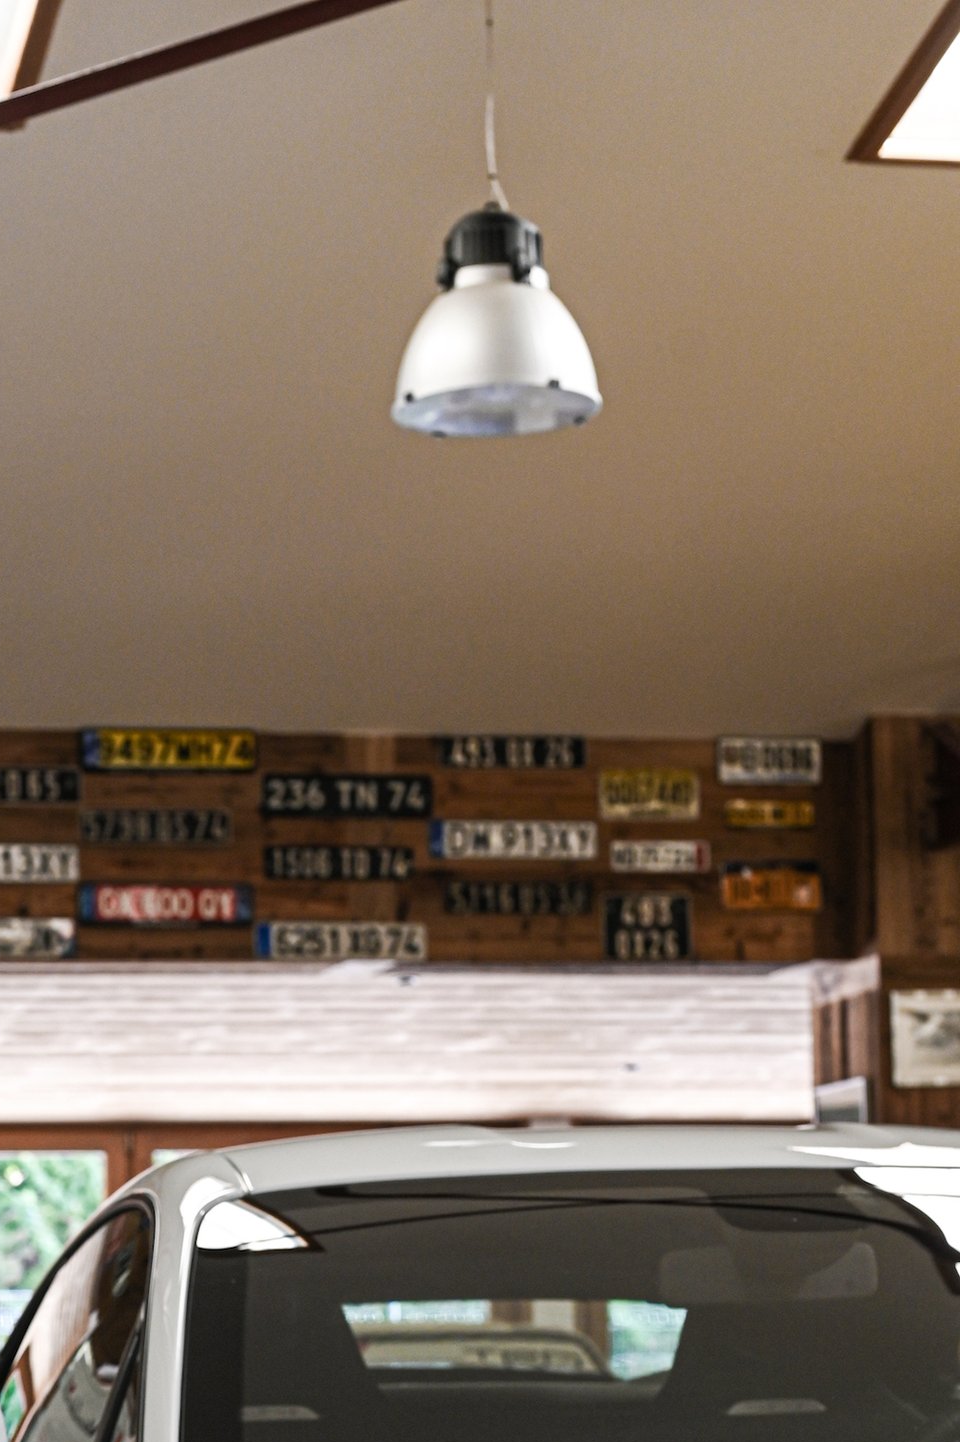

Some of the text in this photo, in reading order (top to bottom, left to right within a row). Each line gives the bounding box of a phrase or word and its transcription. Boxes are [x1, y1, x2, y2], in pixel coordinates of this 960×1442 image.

[265, 778, 426, 811] 236 TN 74
[386, 925, 423, 957] 74
